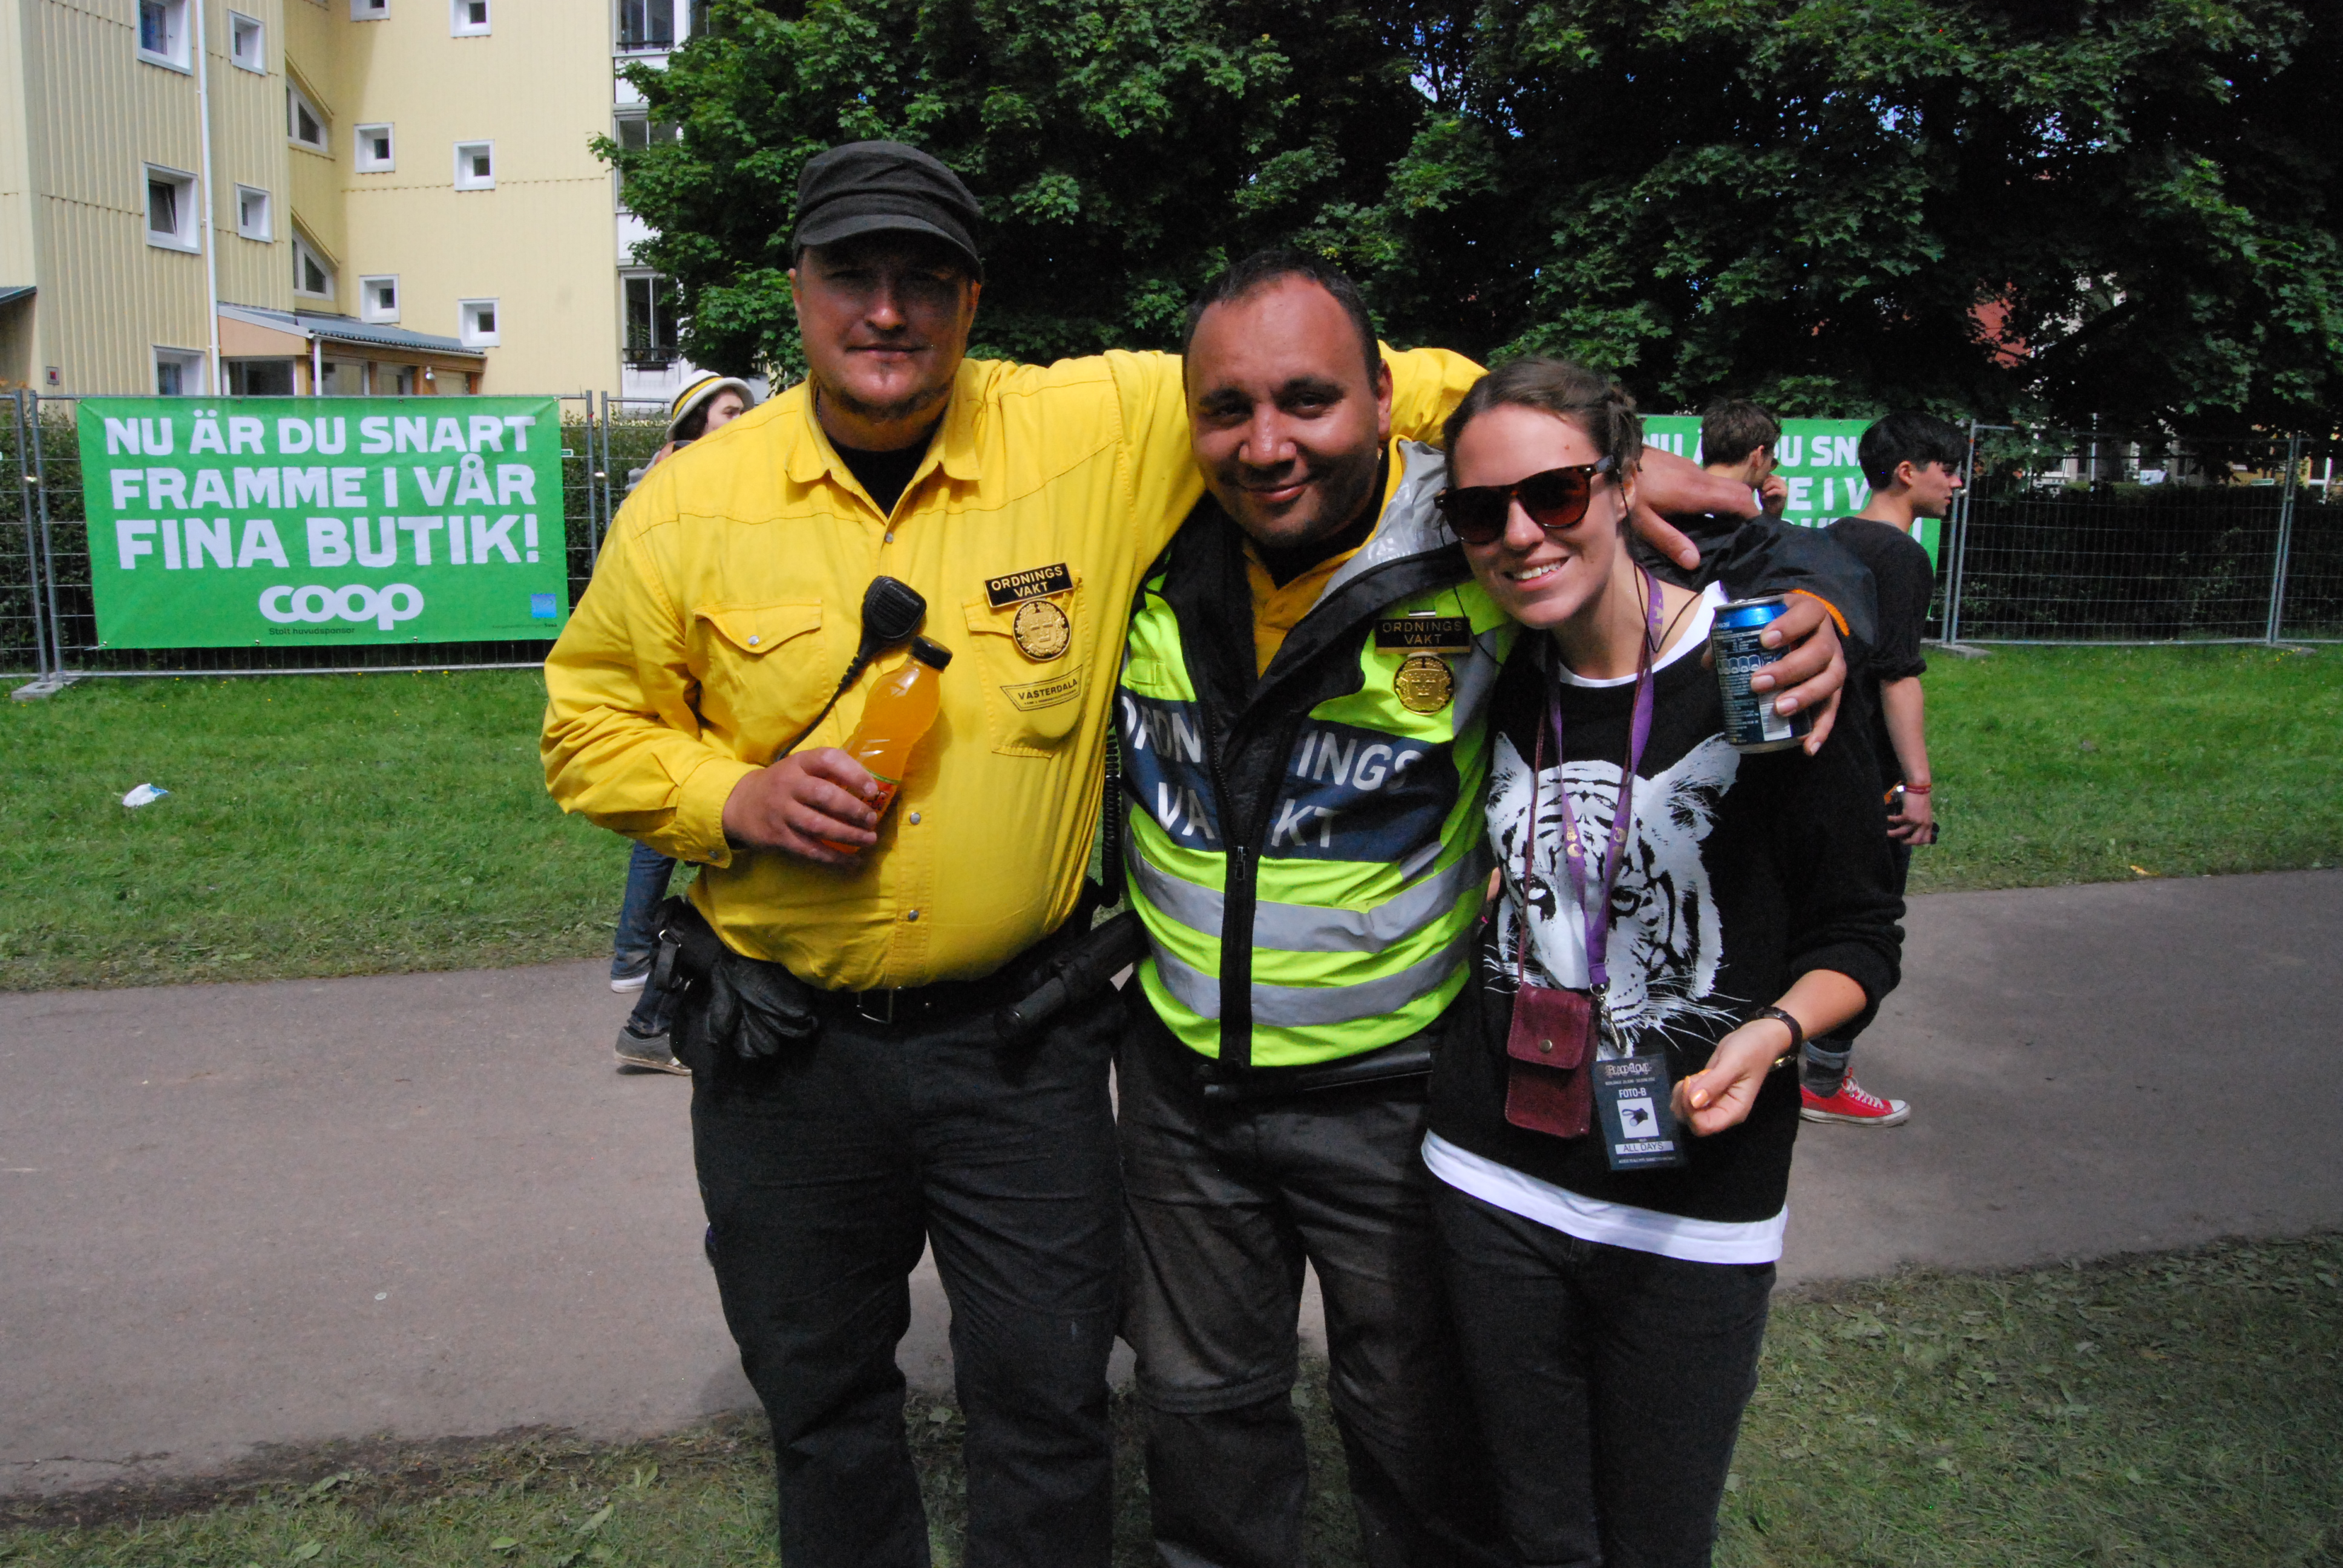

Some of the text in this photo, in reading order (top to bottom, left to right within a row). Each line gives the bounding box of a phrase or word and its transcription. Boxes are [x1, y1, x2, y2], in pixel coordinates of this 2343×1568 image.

[105, 409, 536, 456] NU ÄR DU SNART
[111, 452, 537, 510] FRAMME I VÅR
[116, 514, 539, 569] FINA BUTIK!
[991, 566, 1063, 591] ORDNINGS
[1014, 581, 1048, 598] VAKT
[260, 583, 424, 630] coop
[1382, 621, 1463, 633] ORDNINGS
[1404, 635, 1441, 645] VAKT
[1018, 678, 1078, 700] VÄSTERDALA
[1619, 1088, 1647, 1098] FOTO-B
[1640, 1142, 1663, 1151] DAYS
